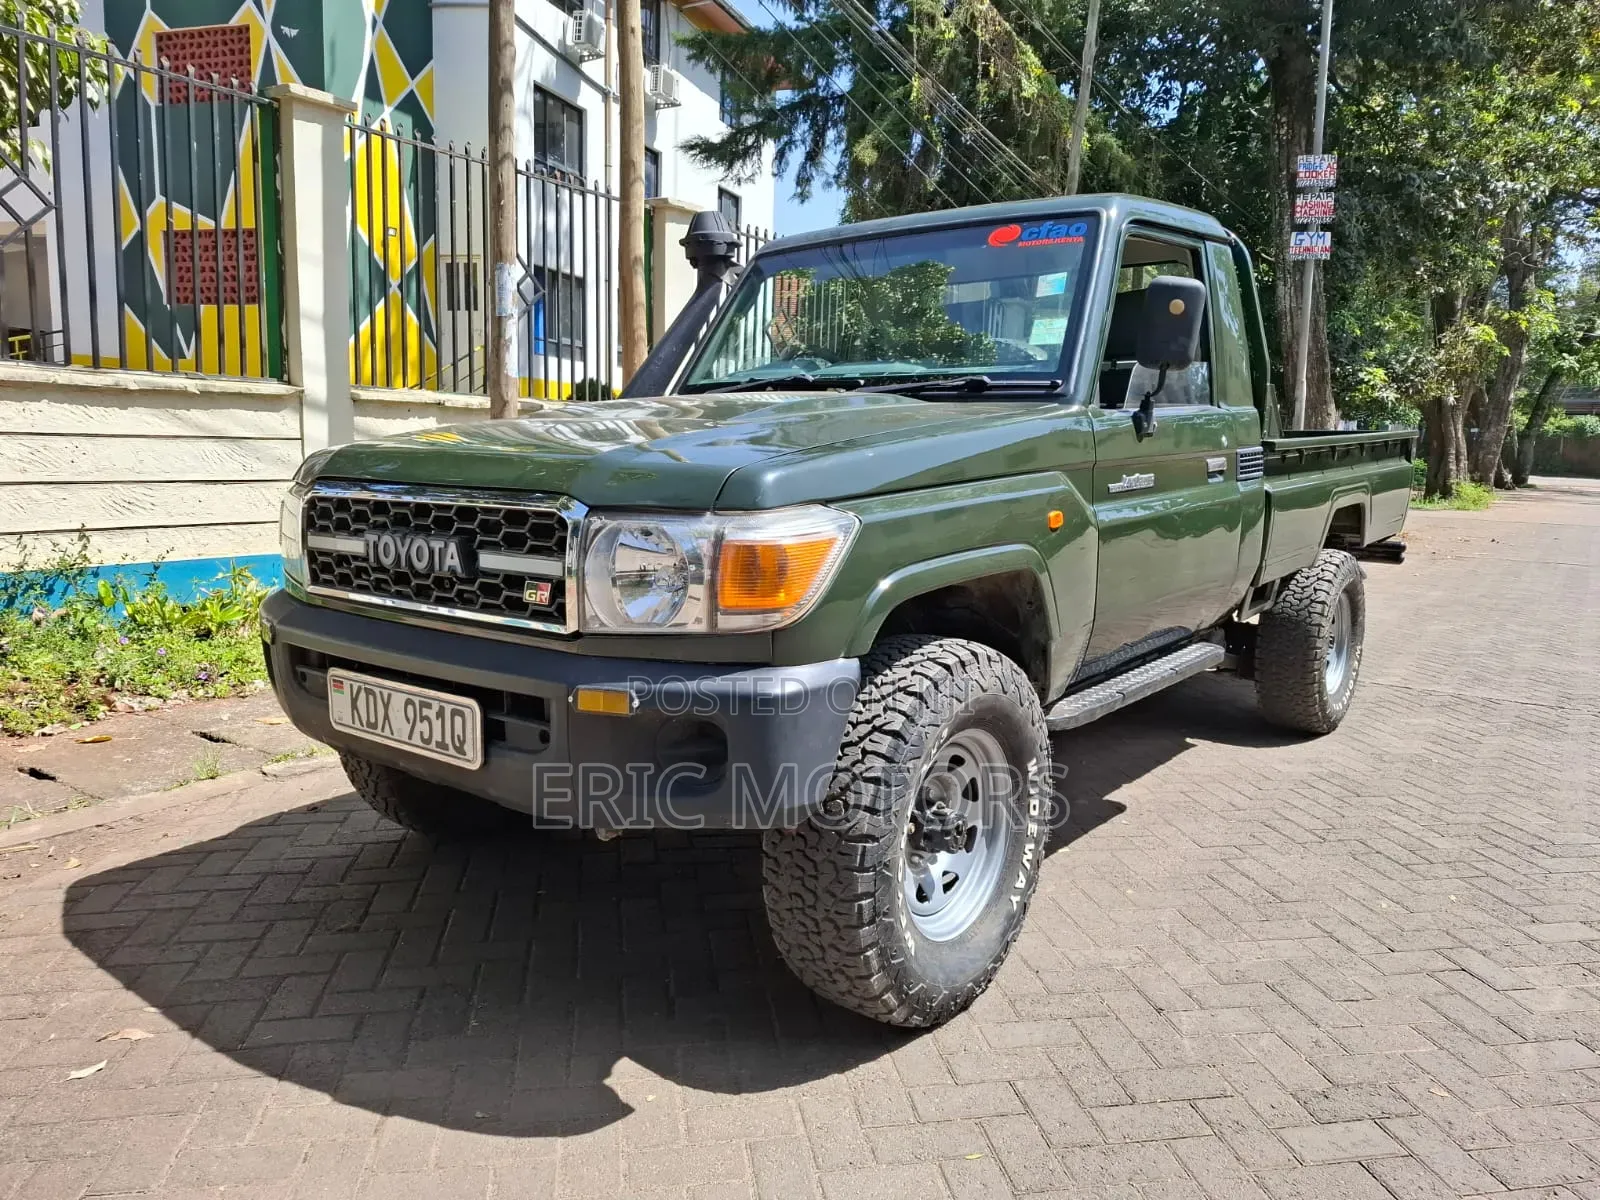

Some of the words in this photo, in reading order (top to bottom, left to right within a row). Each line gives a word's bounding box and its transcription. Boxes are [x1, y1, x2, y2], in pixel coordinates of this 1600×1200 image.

[1298, 155, 1337, 163] REPAIR
[1296, 170, 1336, 179] COOKER
[1296, 192, 1334, 201] REPAIR
[1293, 200, 1335, 209] WASHING
[1293, 208, 1336, 217] MACHINE
[1021, 221, 1088, 241] cfao
[1294, 232, 1326, 245] GYM
[364, 533, 464, 575] TOYOTA
[525, 589, 548, 604] GR
[350, 683, 394, 736] KDX
[403, 697, 467, 756] 951Q
